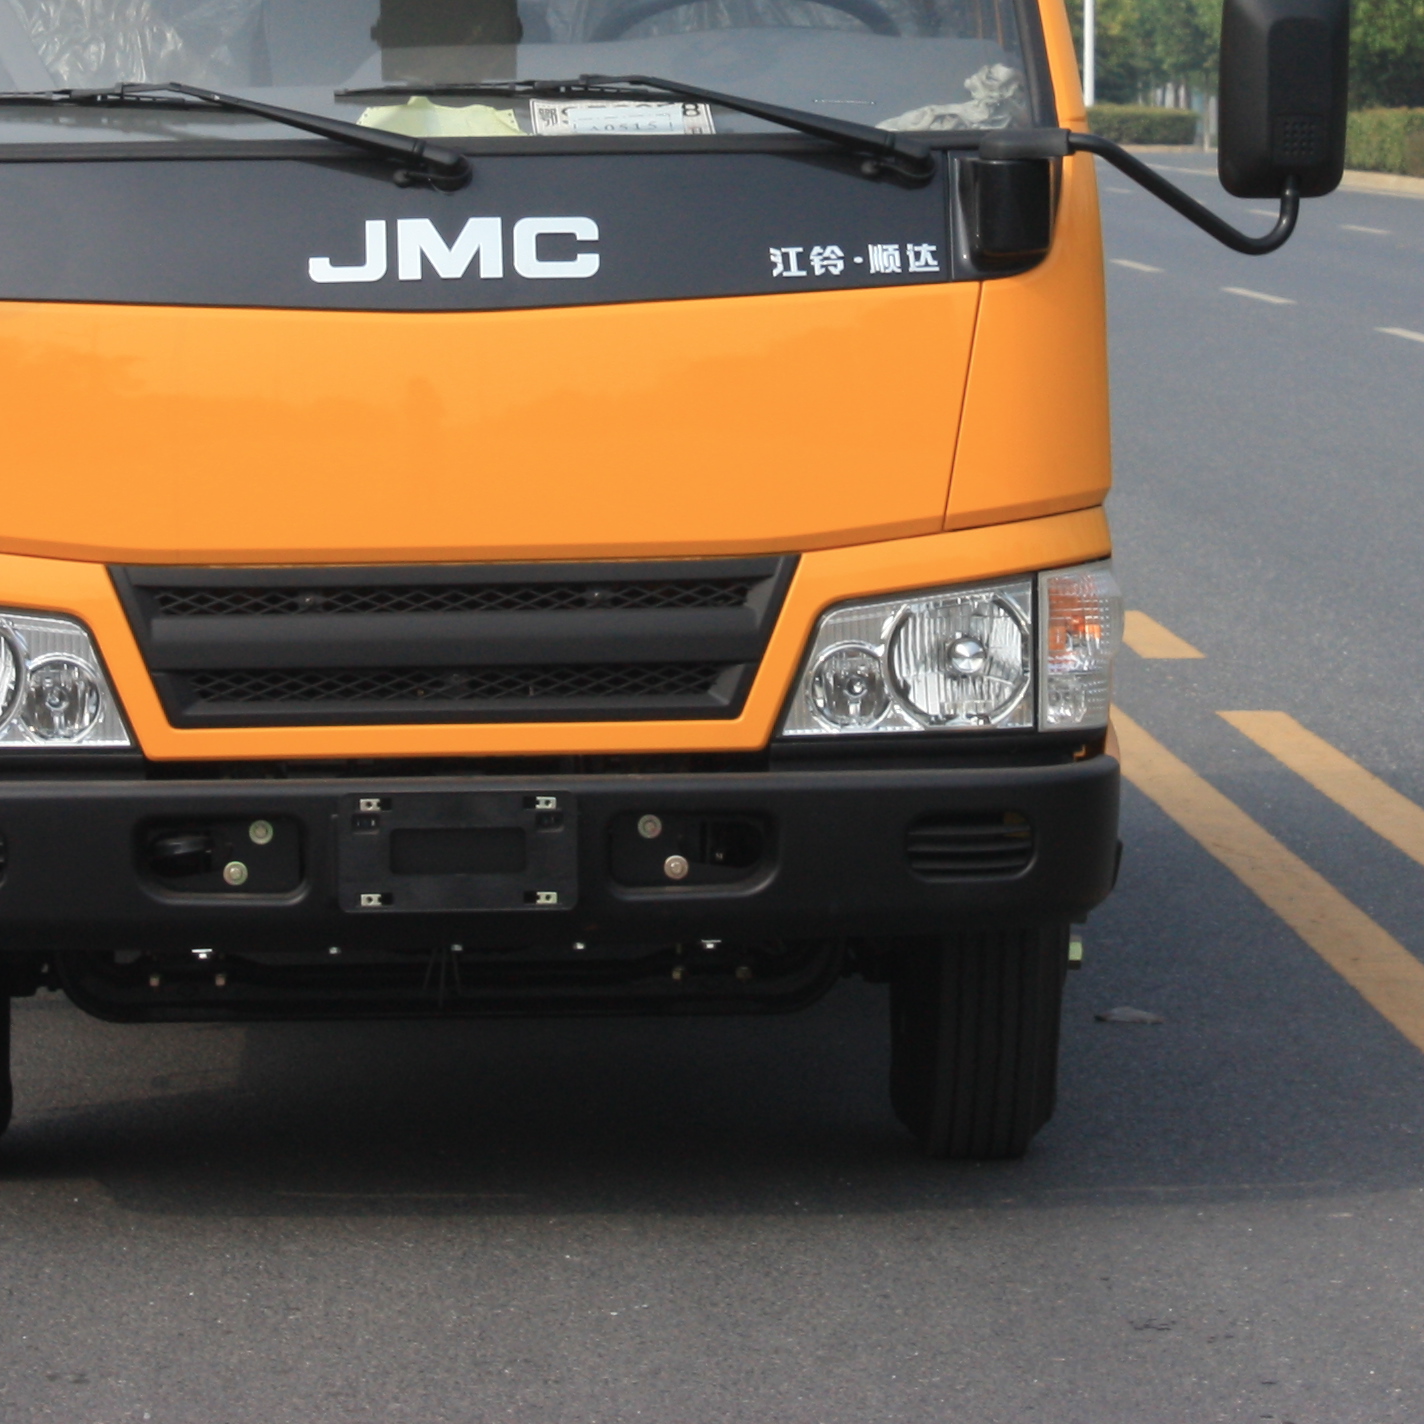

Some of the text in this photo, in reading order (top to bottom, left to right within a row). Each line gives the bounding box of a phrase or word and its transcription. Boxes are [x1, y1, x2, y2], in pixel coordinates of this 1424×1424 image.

[308, 216, 600, 284] JMC
[769, 243, 940, 277] 江铃·顺达
